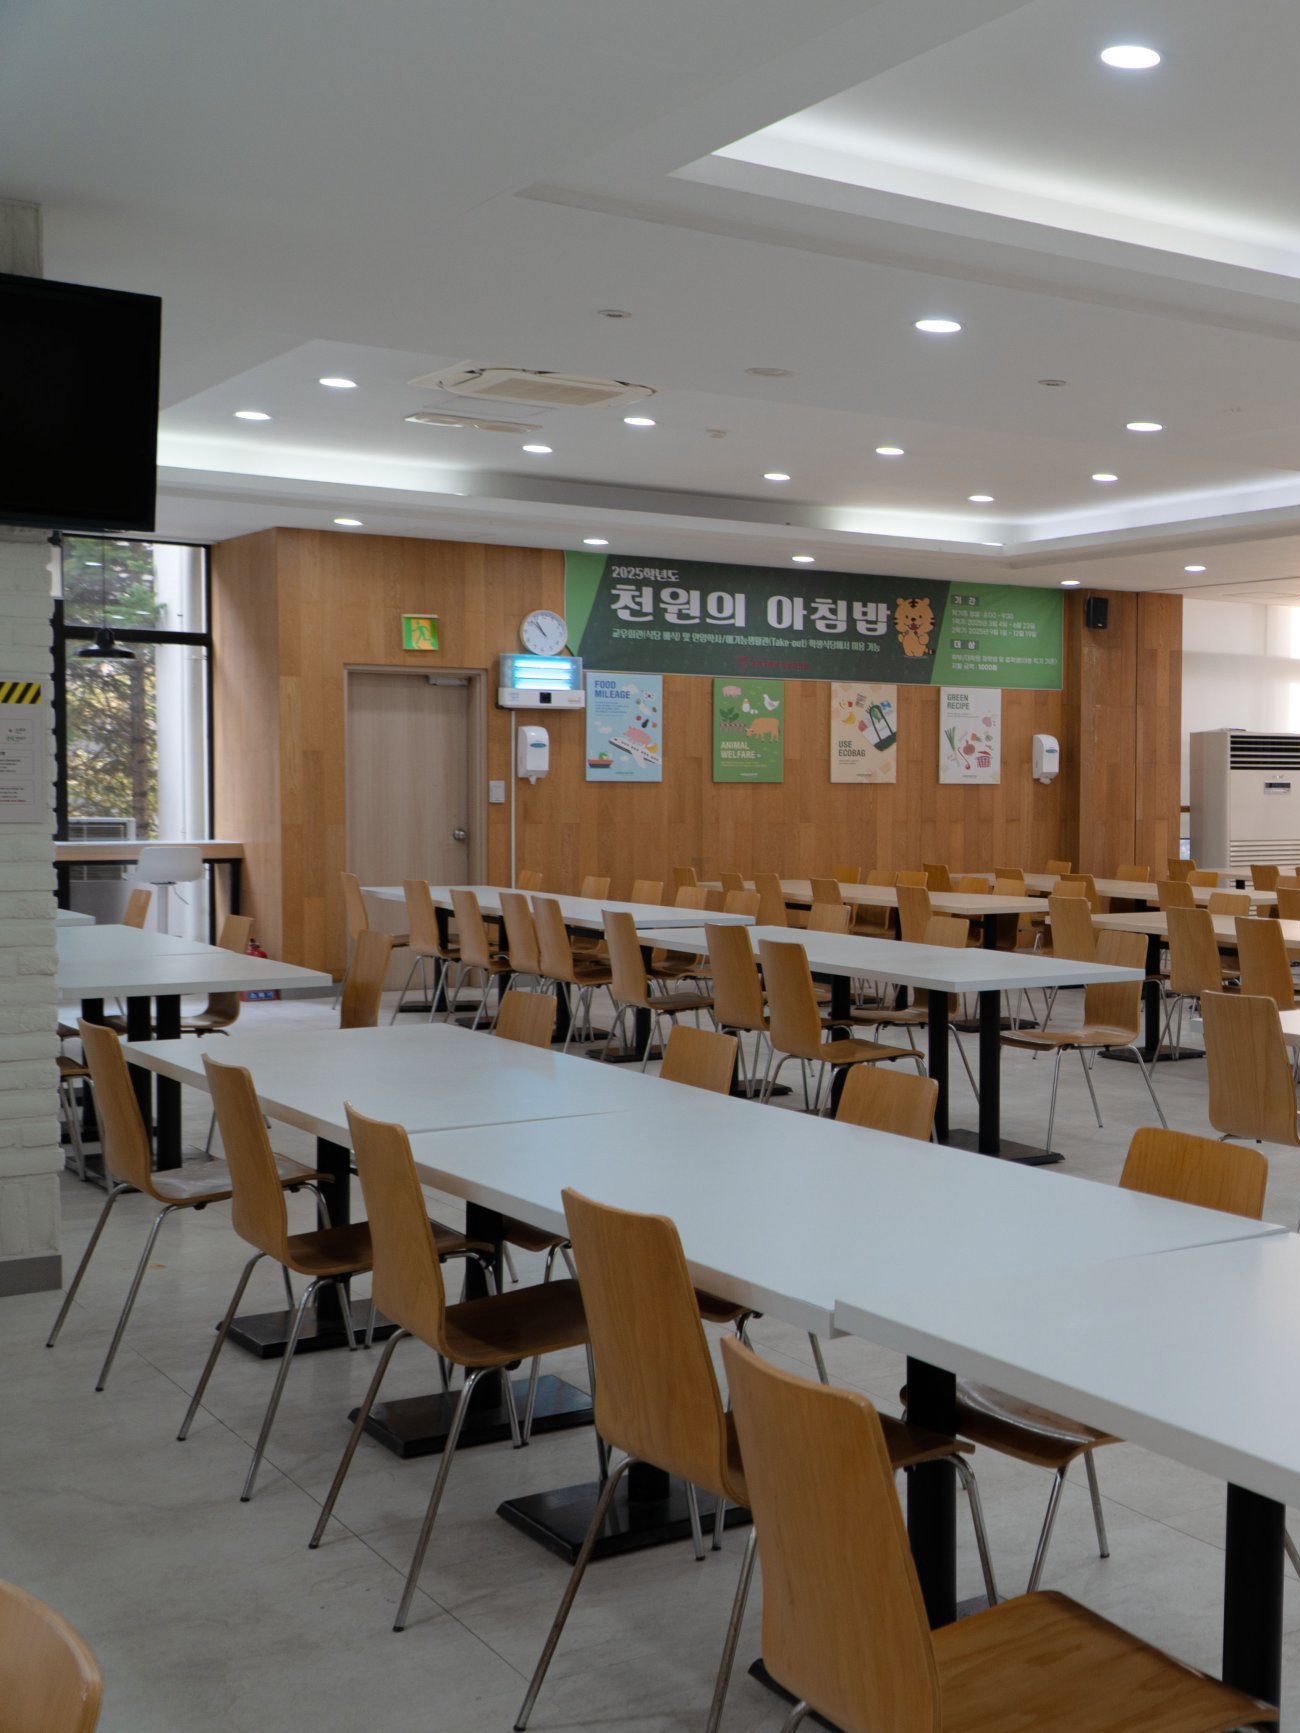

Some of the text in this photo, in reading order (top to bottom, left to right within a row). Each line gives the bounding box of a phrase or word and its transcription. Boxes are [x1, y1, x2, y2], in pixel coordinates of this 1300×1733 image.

[611, 565, 681, 582] 2025학년도
[610, 584, 891, 636] 천원의 아침밥
[594, 680, 616, 689] FOOD
[594, 690, 631, 699] MILEAGE
[947, 694, 969, 702] GREEN
[947, 702, 970, 710] RECIPE
[720, 741, 750, 750] ANIMAL
[838, 740, 853, 748] USE
[720, 750, 756, 759] WELFARE
[838, 749, 866, 757] ECOBAG
